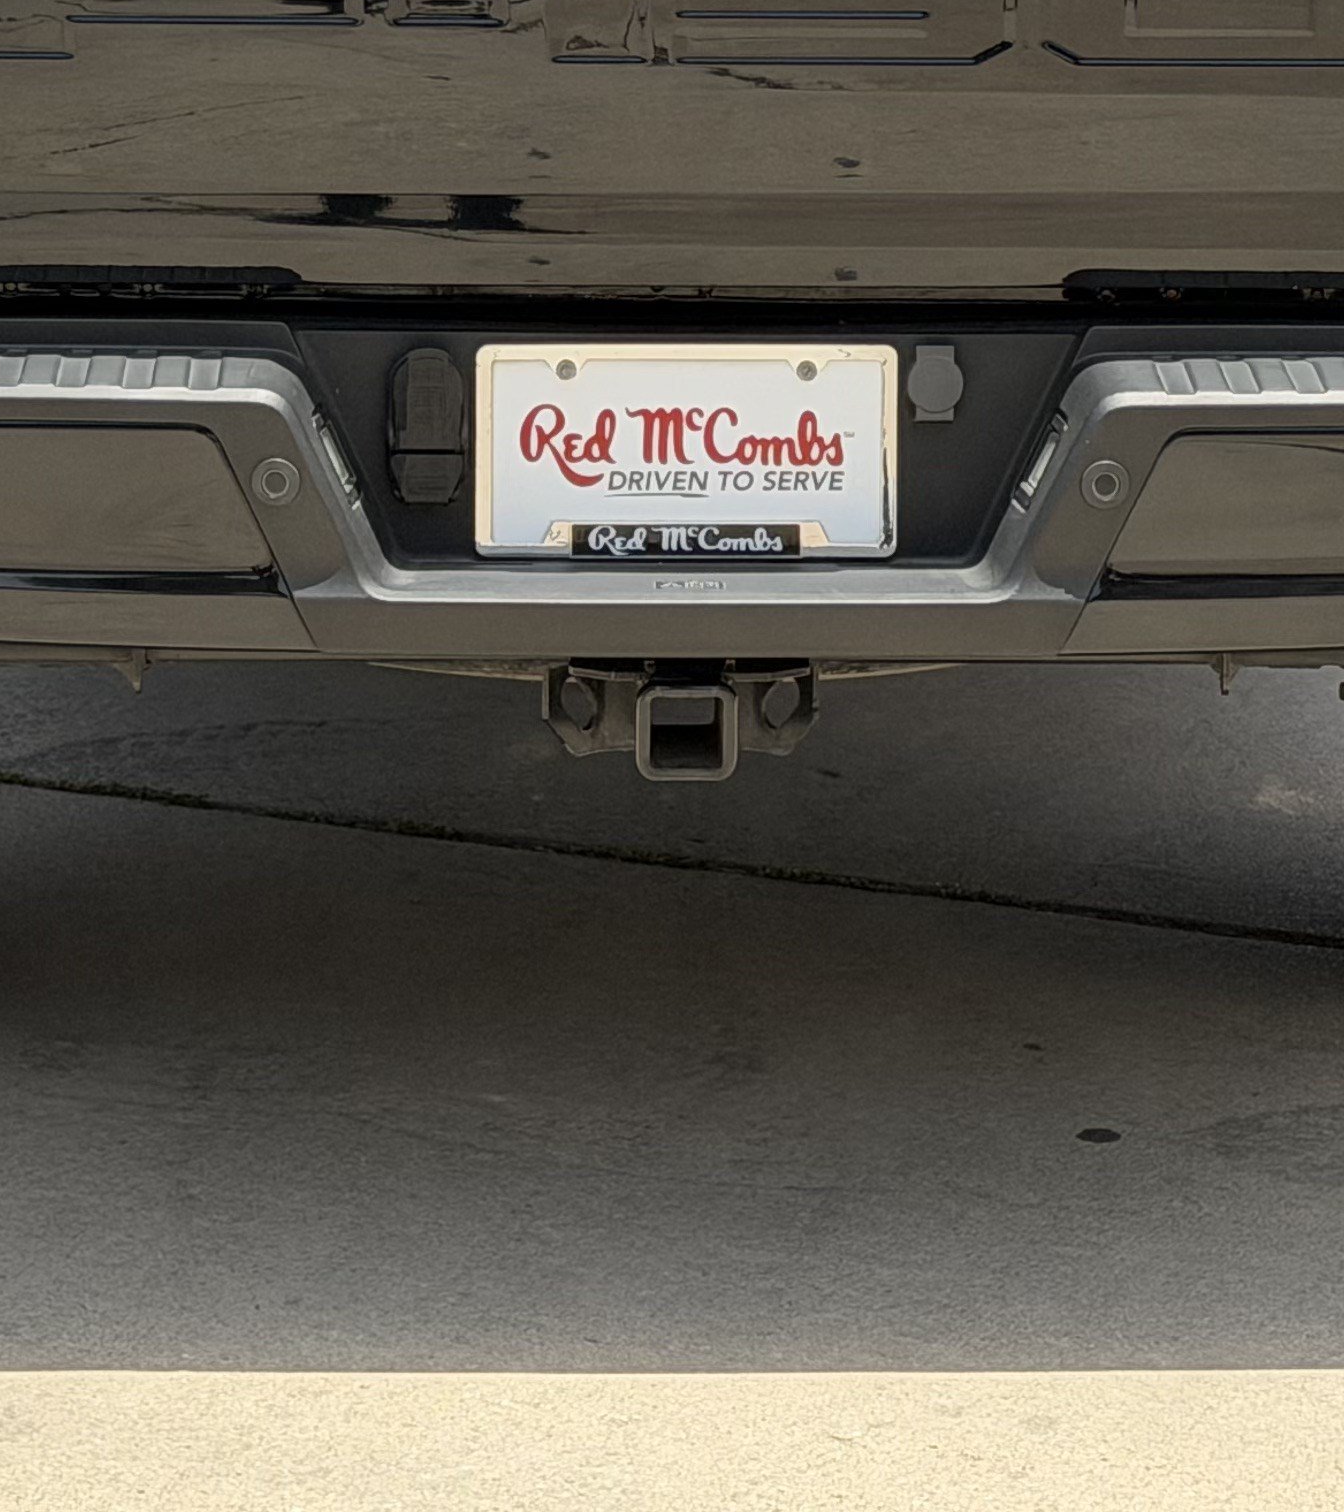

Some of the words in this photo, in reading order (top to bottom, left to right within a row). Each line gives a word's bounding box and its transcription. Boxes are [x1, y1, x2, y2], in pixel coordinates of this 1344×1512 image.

[519, 403, 617, 487] Red
[625, 406, 845, 466] McCombs
[607, 470, 710, 493] DRIVEN
[718, 470, 755, 493] TO
[762, 470, 846, 493] SERVE
[588, 525, 648, 556] Red
[652, 526, 784, 553] McCombs
